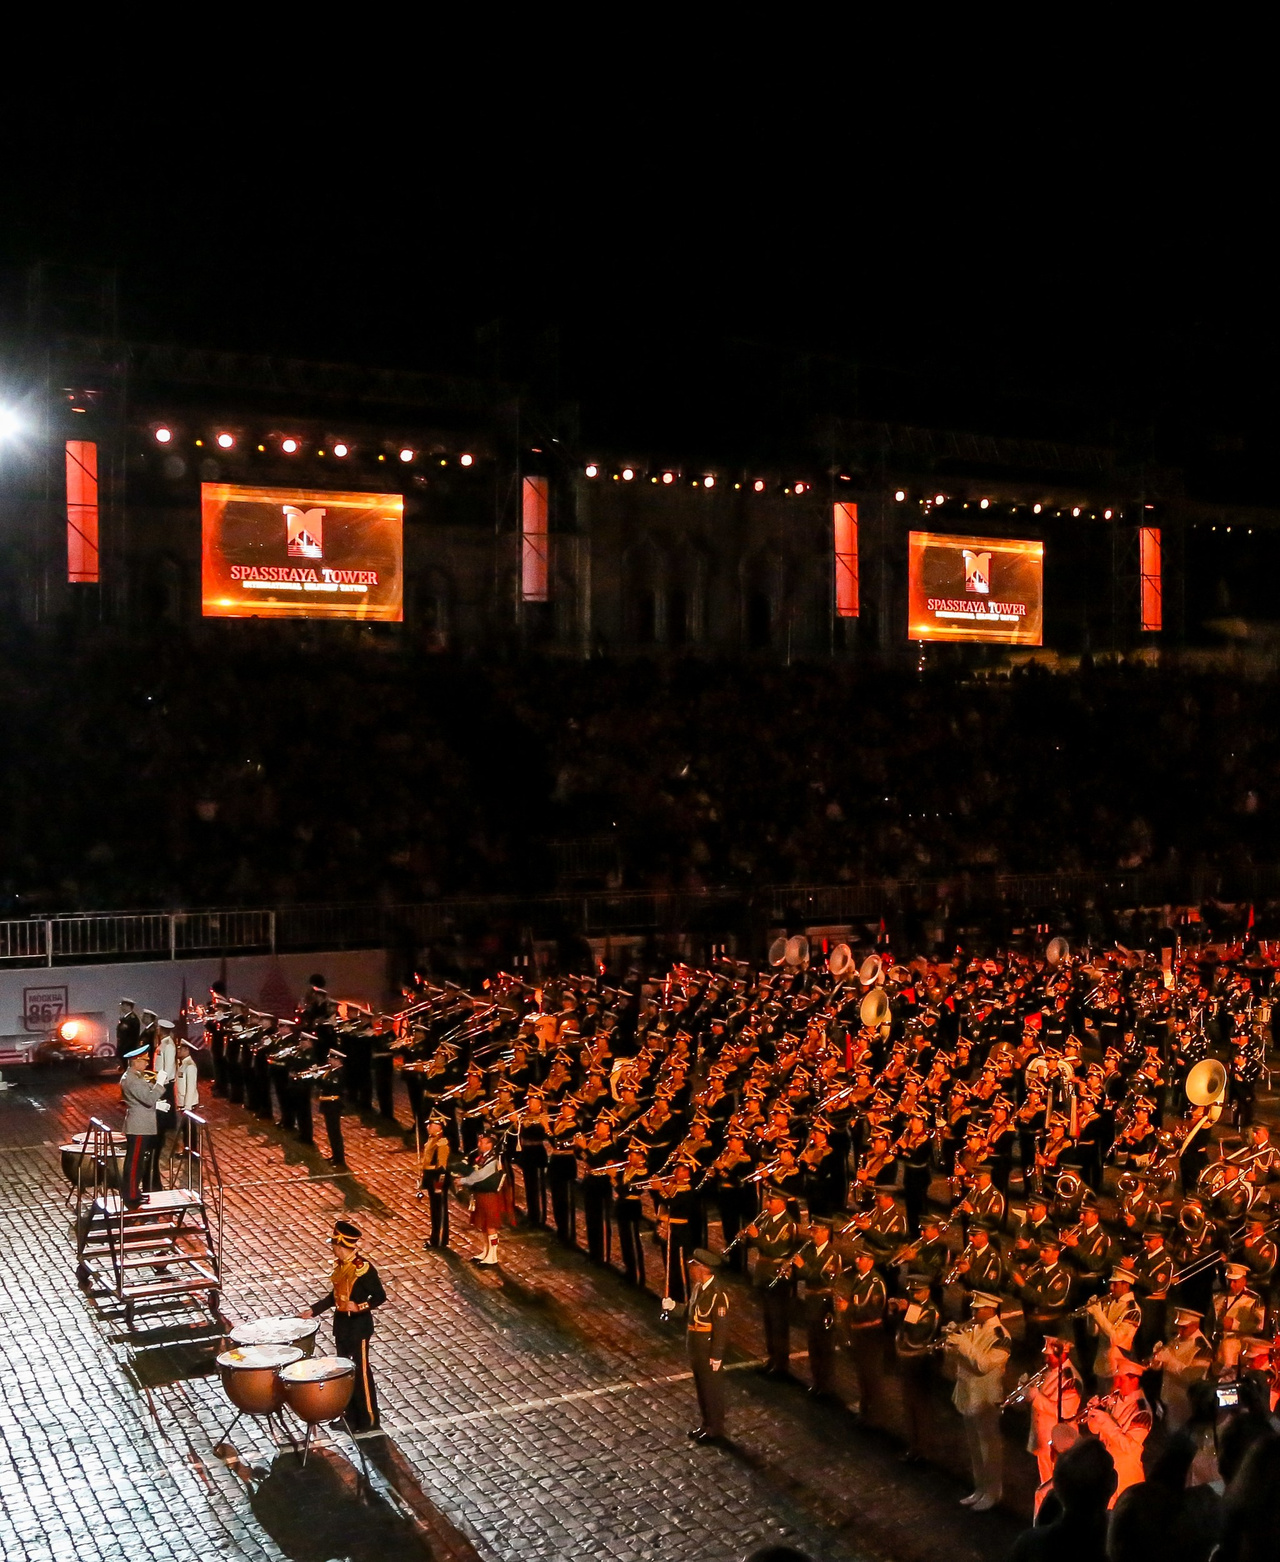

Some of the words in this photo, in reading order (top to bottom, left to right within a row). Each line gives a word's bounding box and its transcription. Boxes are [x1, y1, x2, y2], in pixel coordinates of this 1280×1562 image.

[230, 565, 318, 582] SPASSKAYA
[322, 568, 378, 585] TOWER
[927, 598, 986, 612] SPASSKAYA
[988, 600, 1026, 615] TOWER
[29, 1003, 64, 1023] 867
